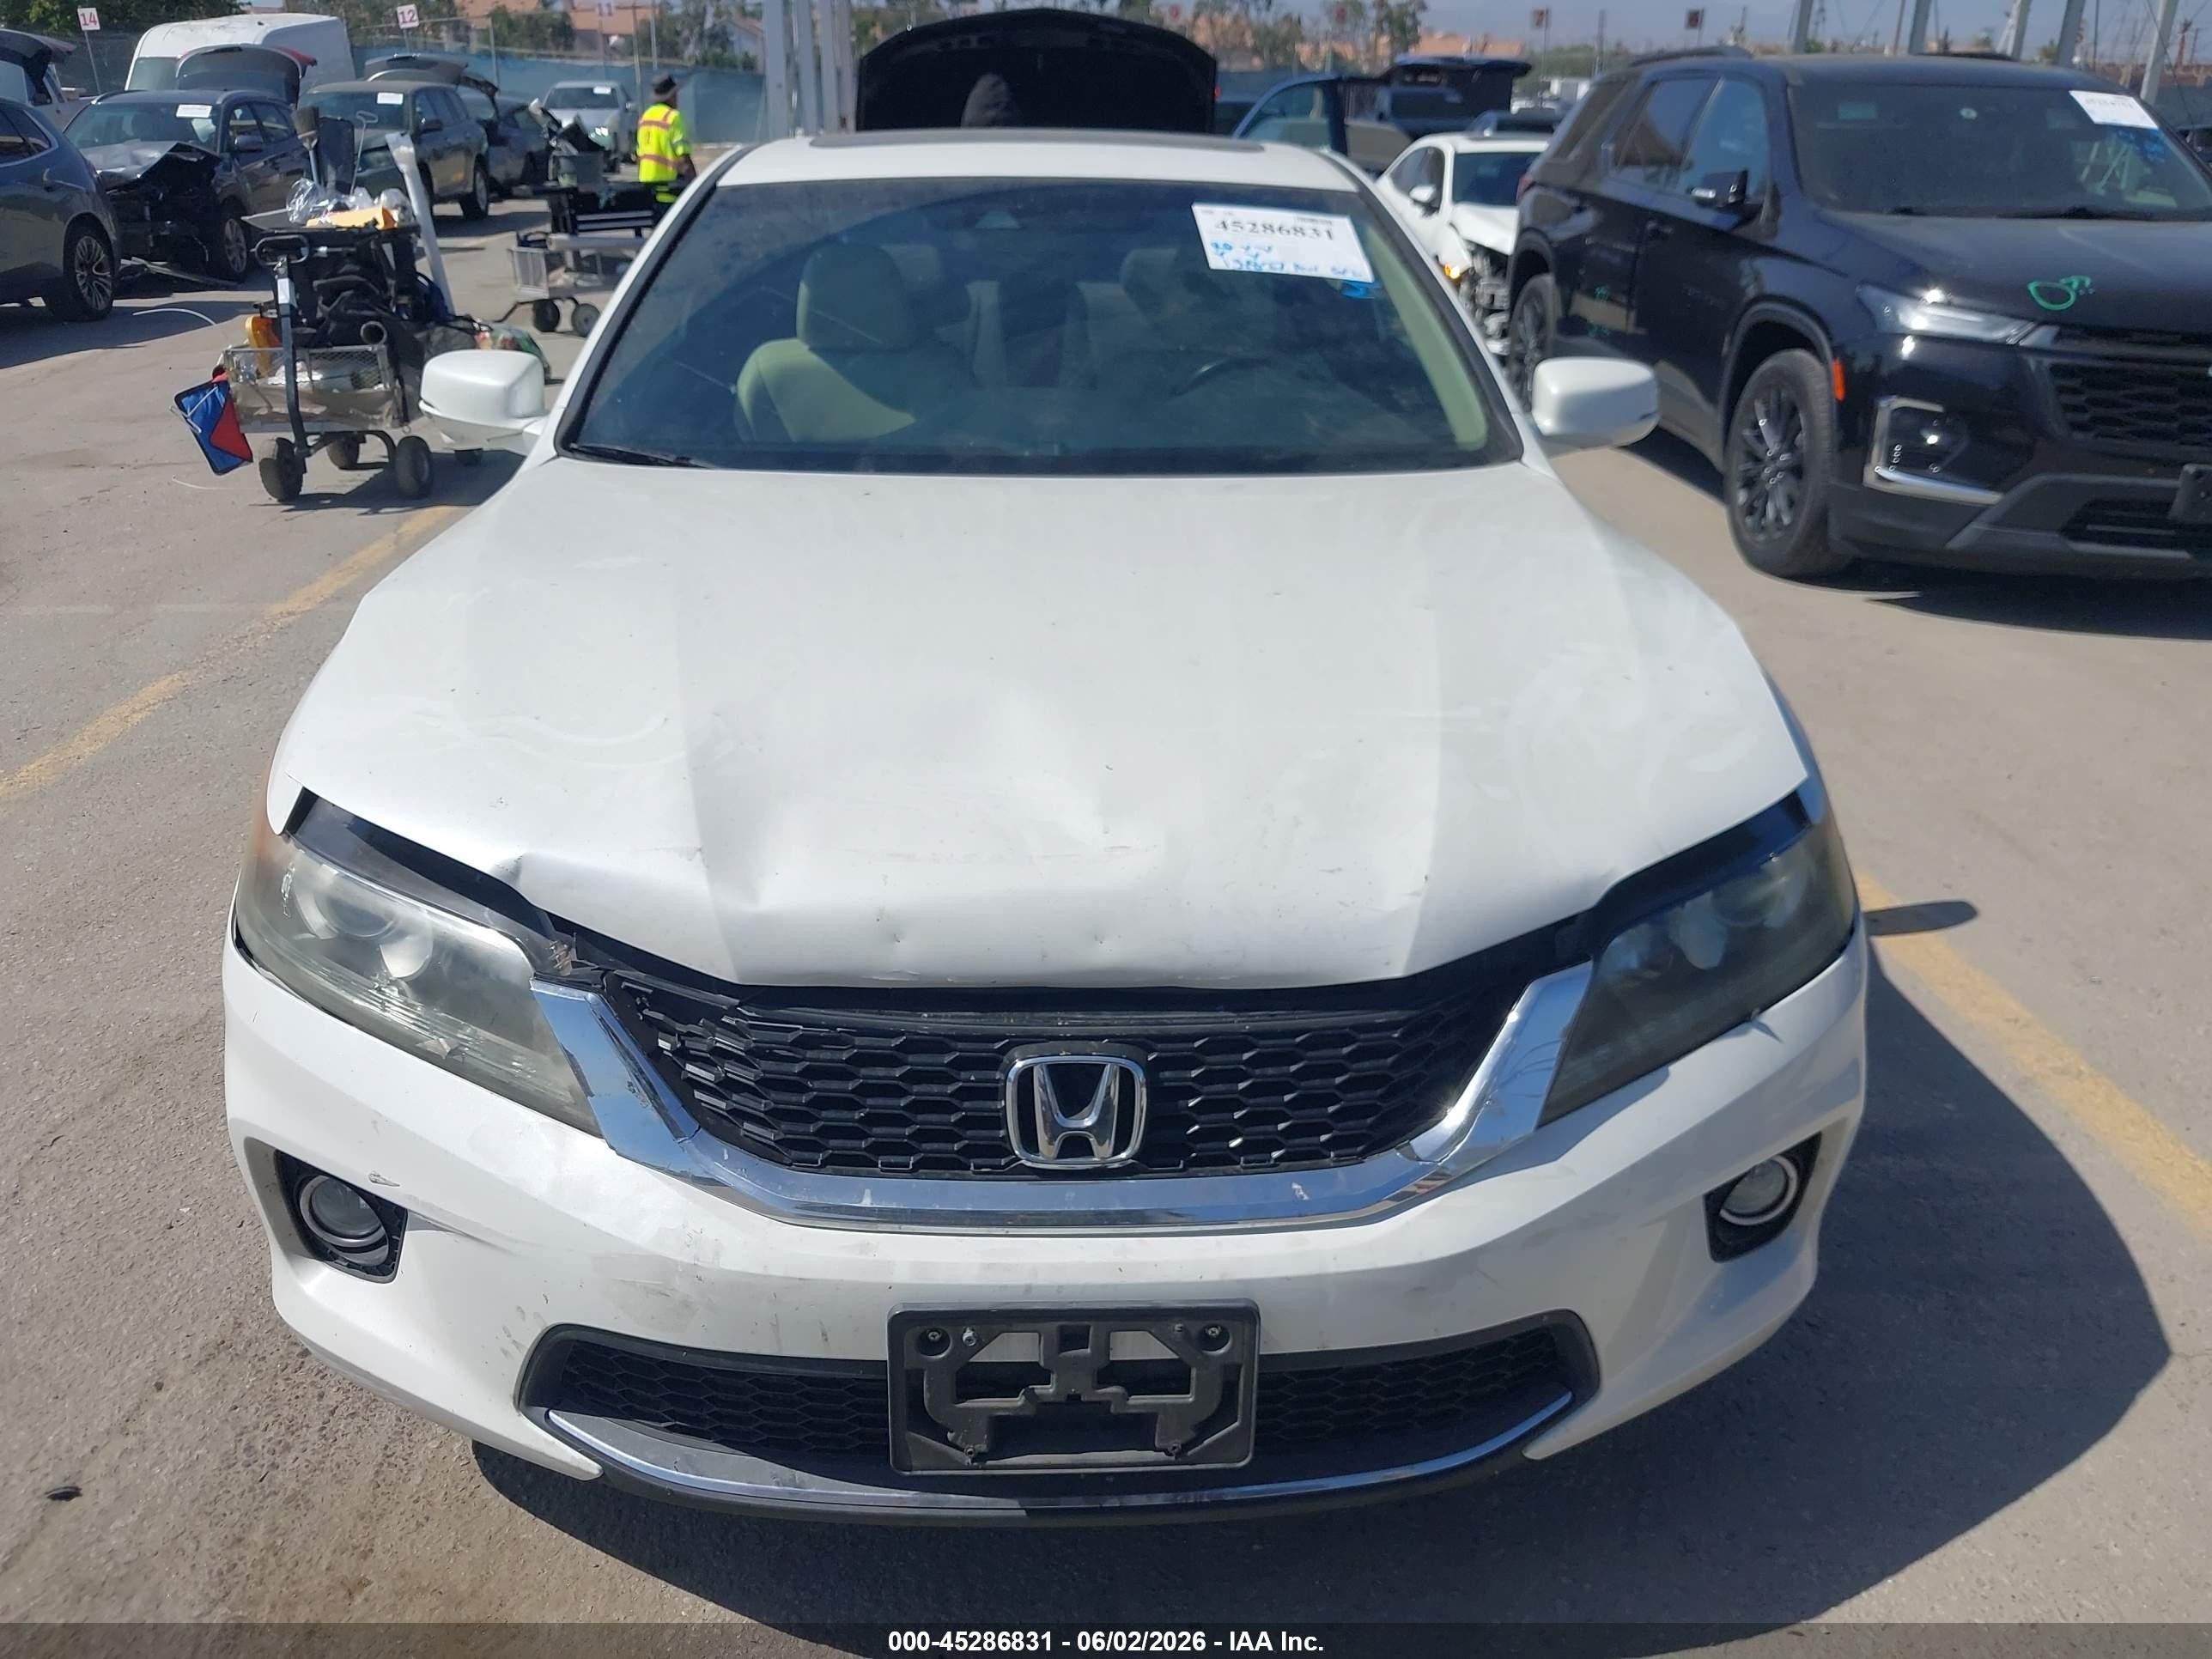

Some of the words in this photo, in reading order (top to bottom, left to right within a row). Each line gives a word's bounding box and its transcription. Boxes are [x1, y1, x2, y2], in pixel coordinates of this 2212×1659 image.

[80, 12, 97, 26] 14
[399, 9, 416, 23] 12
[1215, 220, 1334, 240] 45286831
